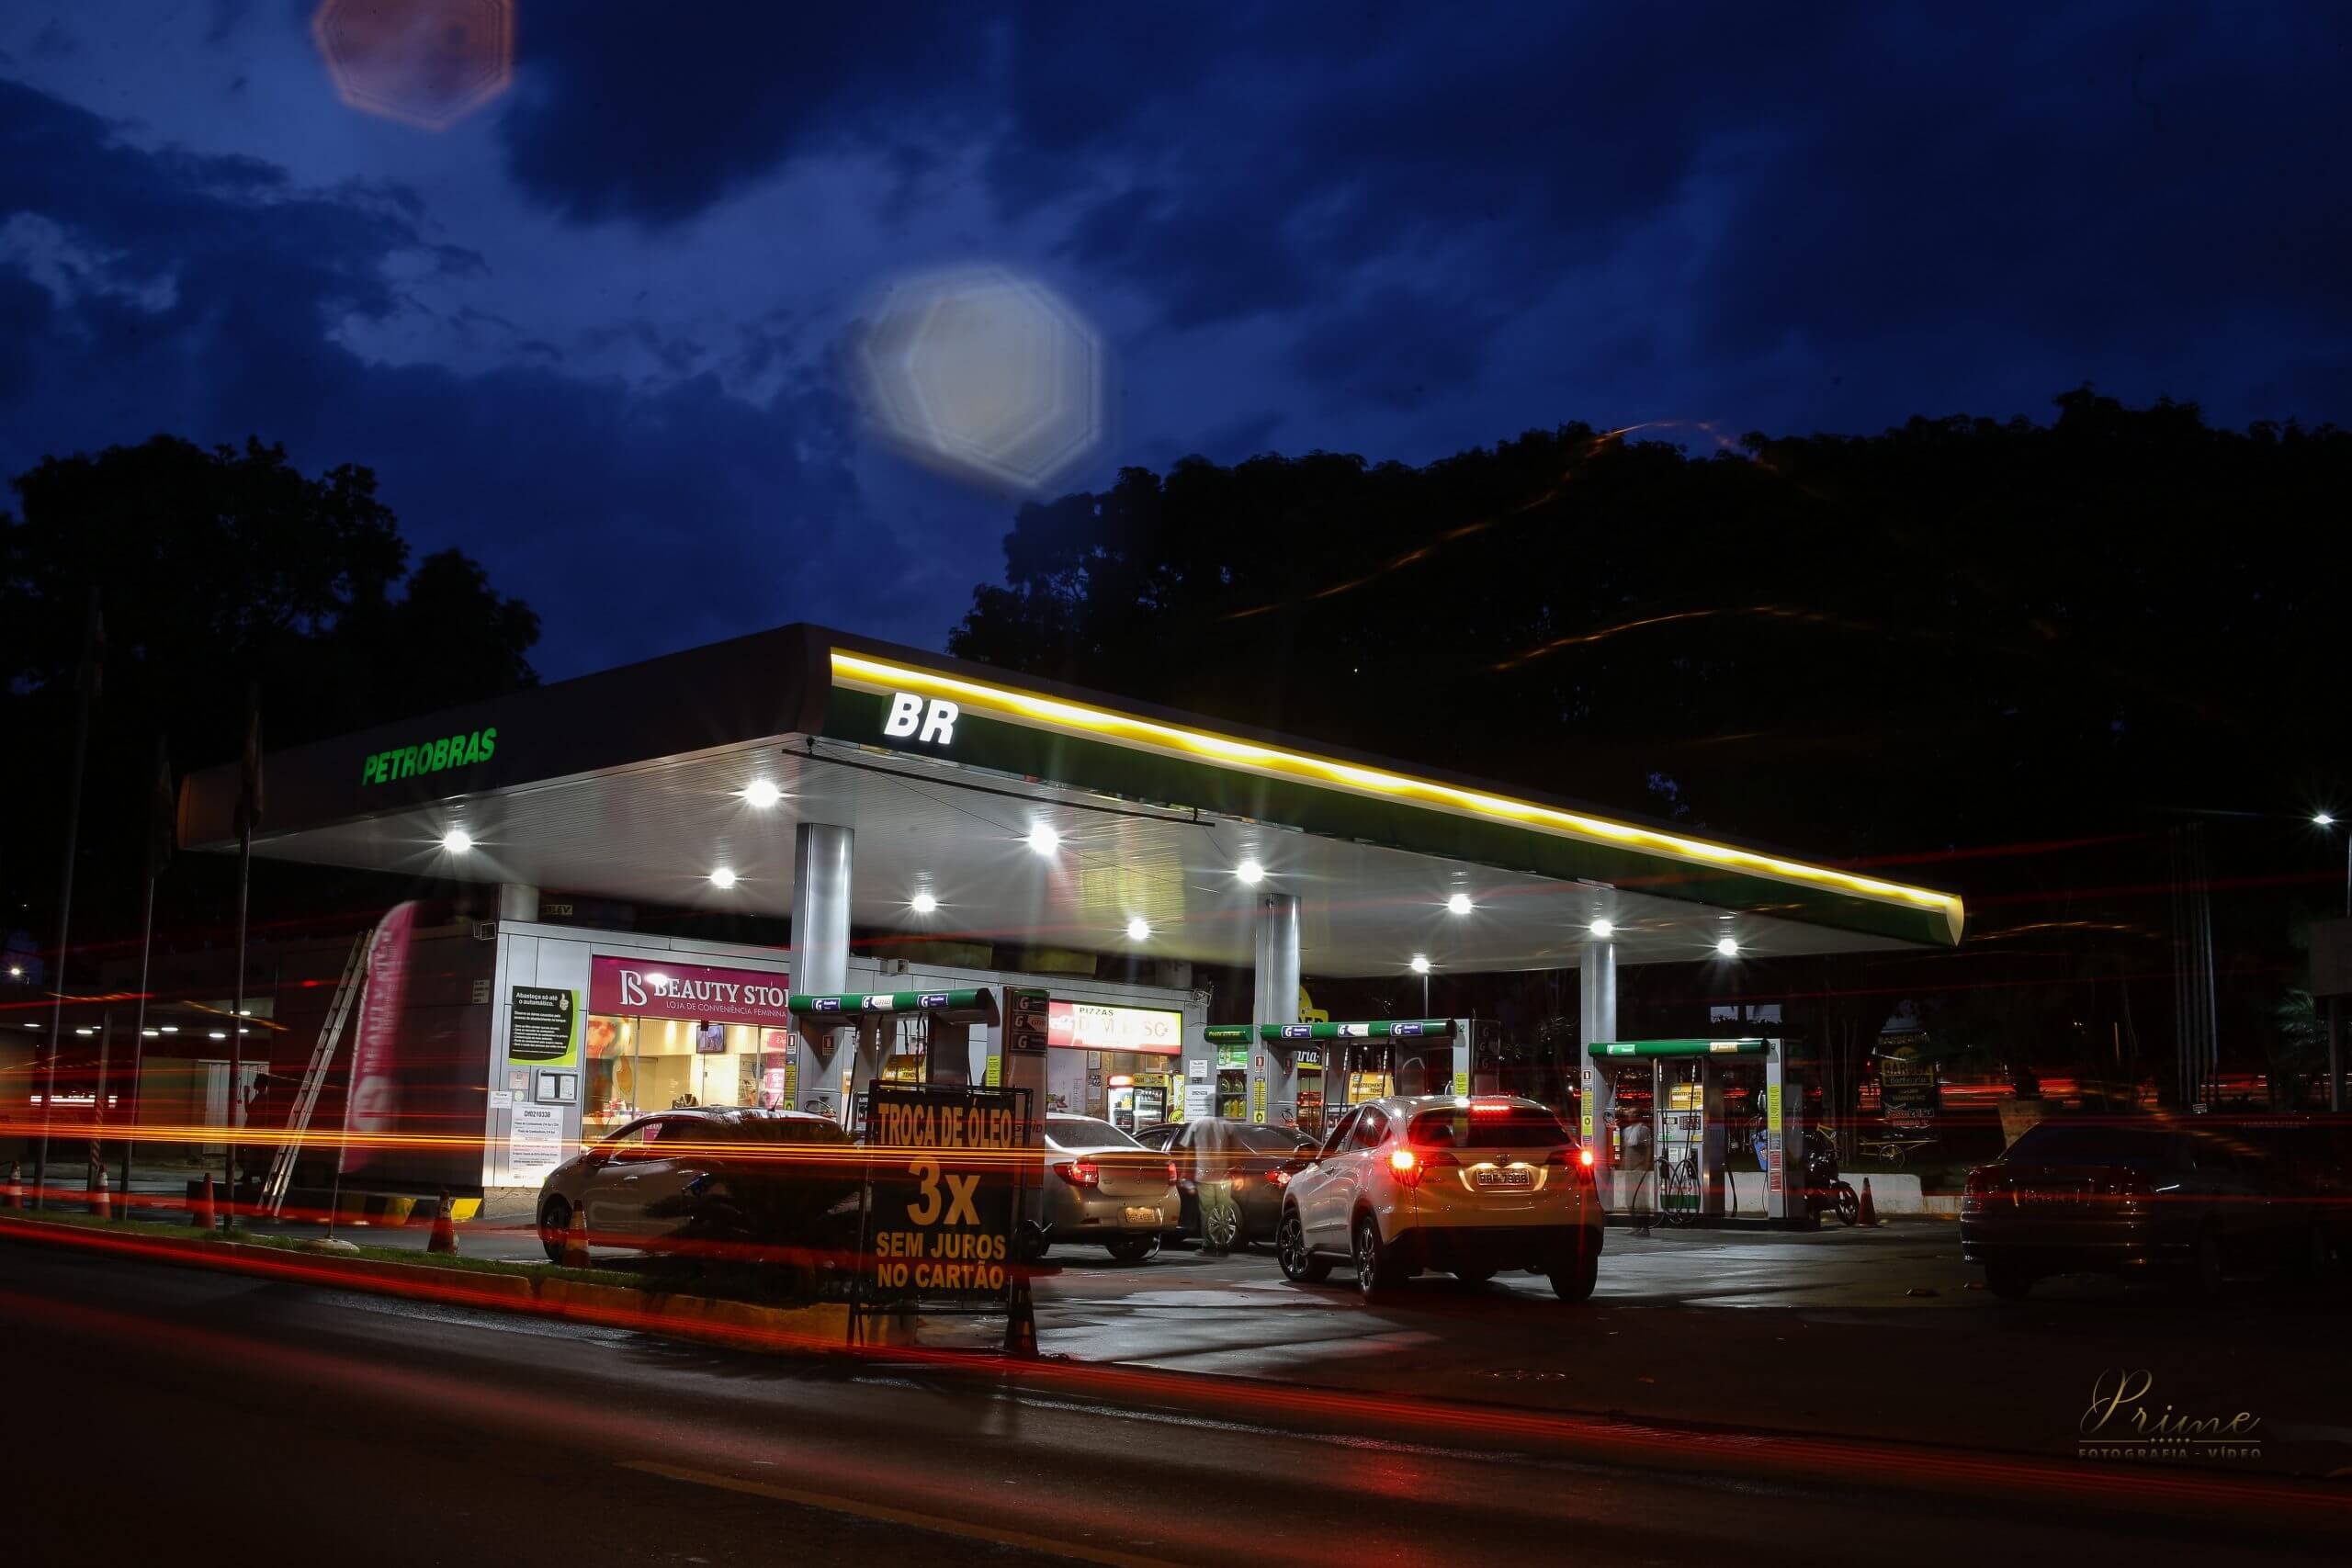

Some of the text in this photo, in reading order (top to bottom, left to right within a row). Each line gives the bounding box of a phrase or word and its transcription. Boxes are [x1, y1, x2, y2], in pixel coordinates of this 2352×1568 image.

[884, 692, 959, 745] BR
[361, 727, 497, 786] PETROBRAS
[653, 976, 741, 1003] BEAUTY
[666, 1000, 685, 1010] LOJA
[697, 1004, 752, 1016] CONVENIÊNCIA
[753, 1008, 787, 1019] FEMININA
[1079, 1007, 1114, 1016] PIZZAS
[878, 1098, 1012, 1148] TROCA DE ÓLEO
[876, 1232, 1006, 1259] SEM JUROS
[877, 1259, 1004, 1290] NO CARTÃO
